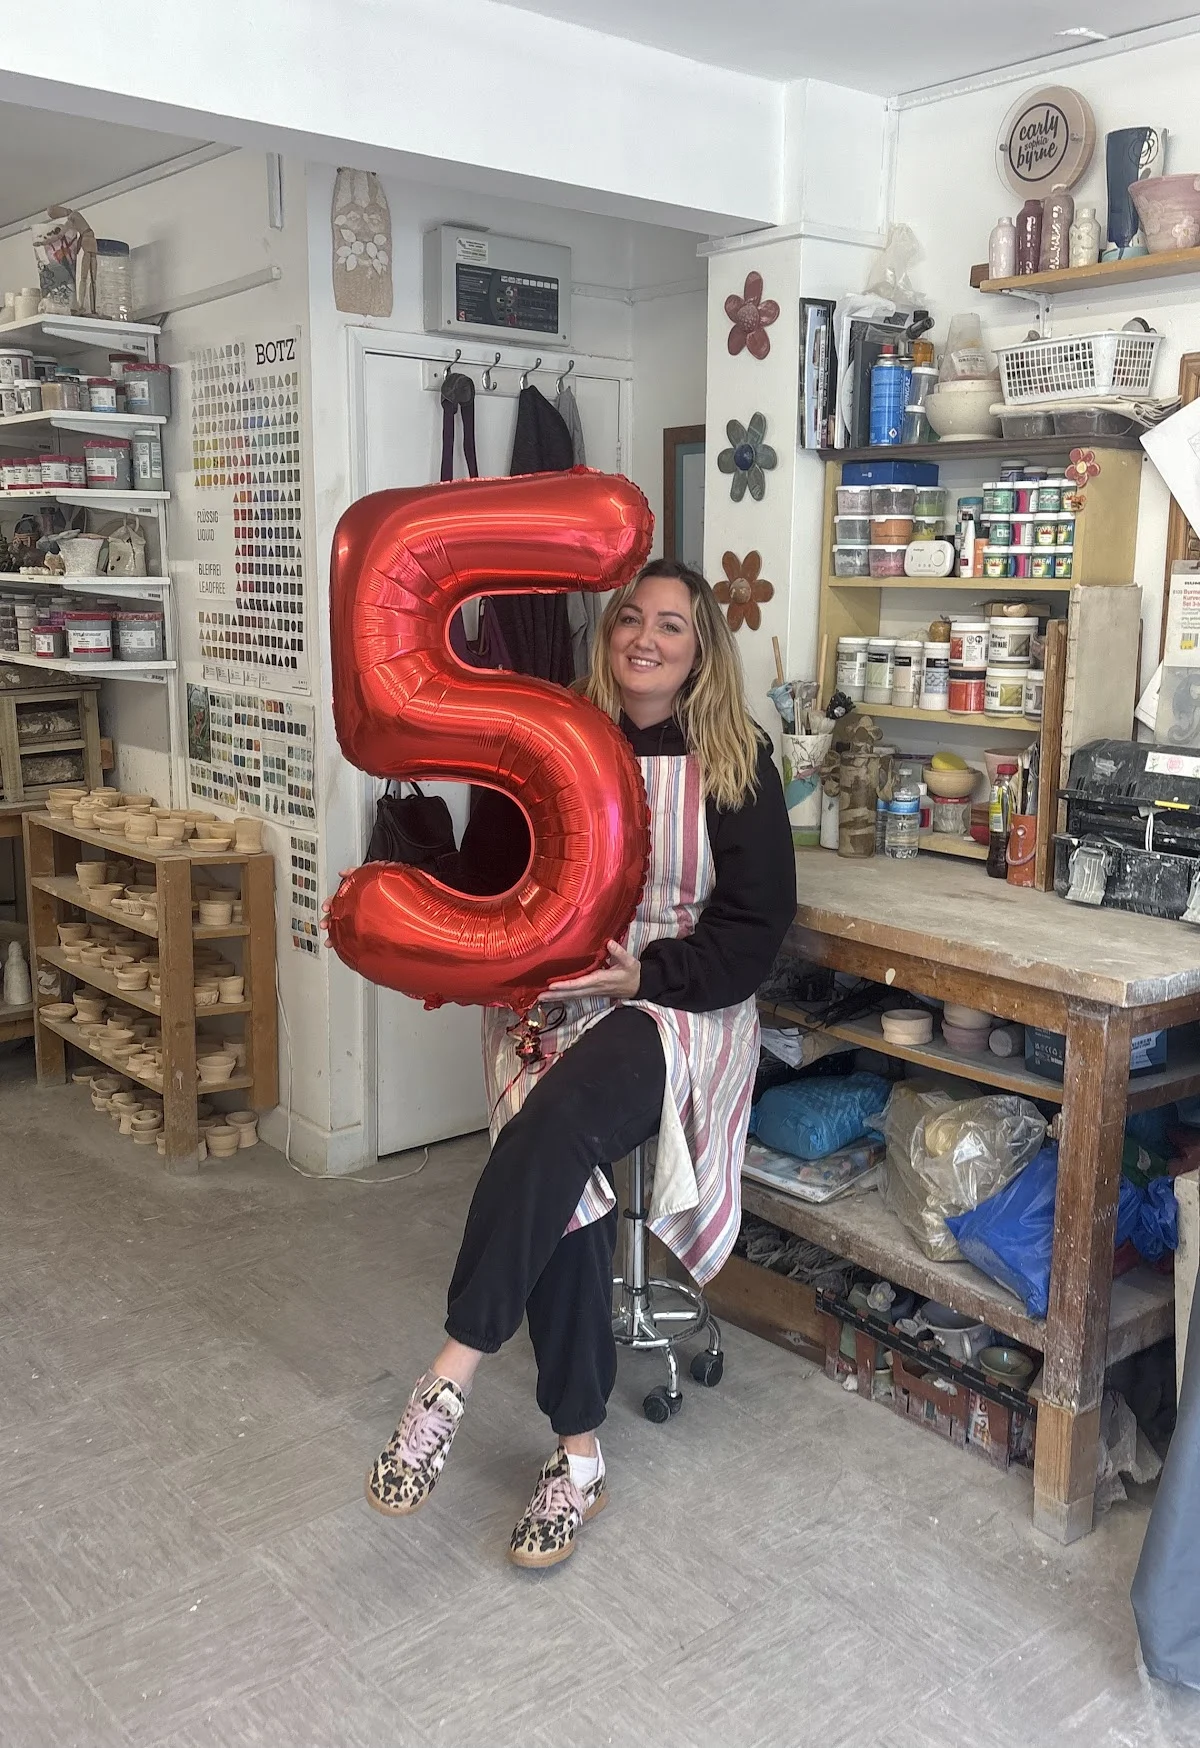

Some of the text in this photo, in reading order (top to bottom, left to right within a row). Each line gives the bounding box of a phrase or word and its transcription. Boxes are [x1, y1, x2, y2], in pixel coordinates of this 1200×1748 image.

[1019, 109, 1059, 141] carly
[1016, 142, 1058, 172] byrne
[255, 338, 295, 365] BOTZ
[196, 509, 219, 523] FLÜSSIG
[197, 529, 215, 541] LIQUID
[198, 563, 222, 576] BLEIFREI
[199, 580, 226, 595] LEADFREE
